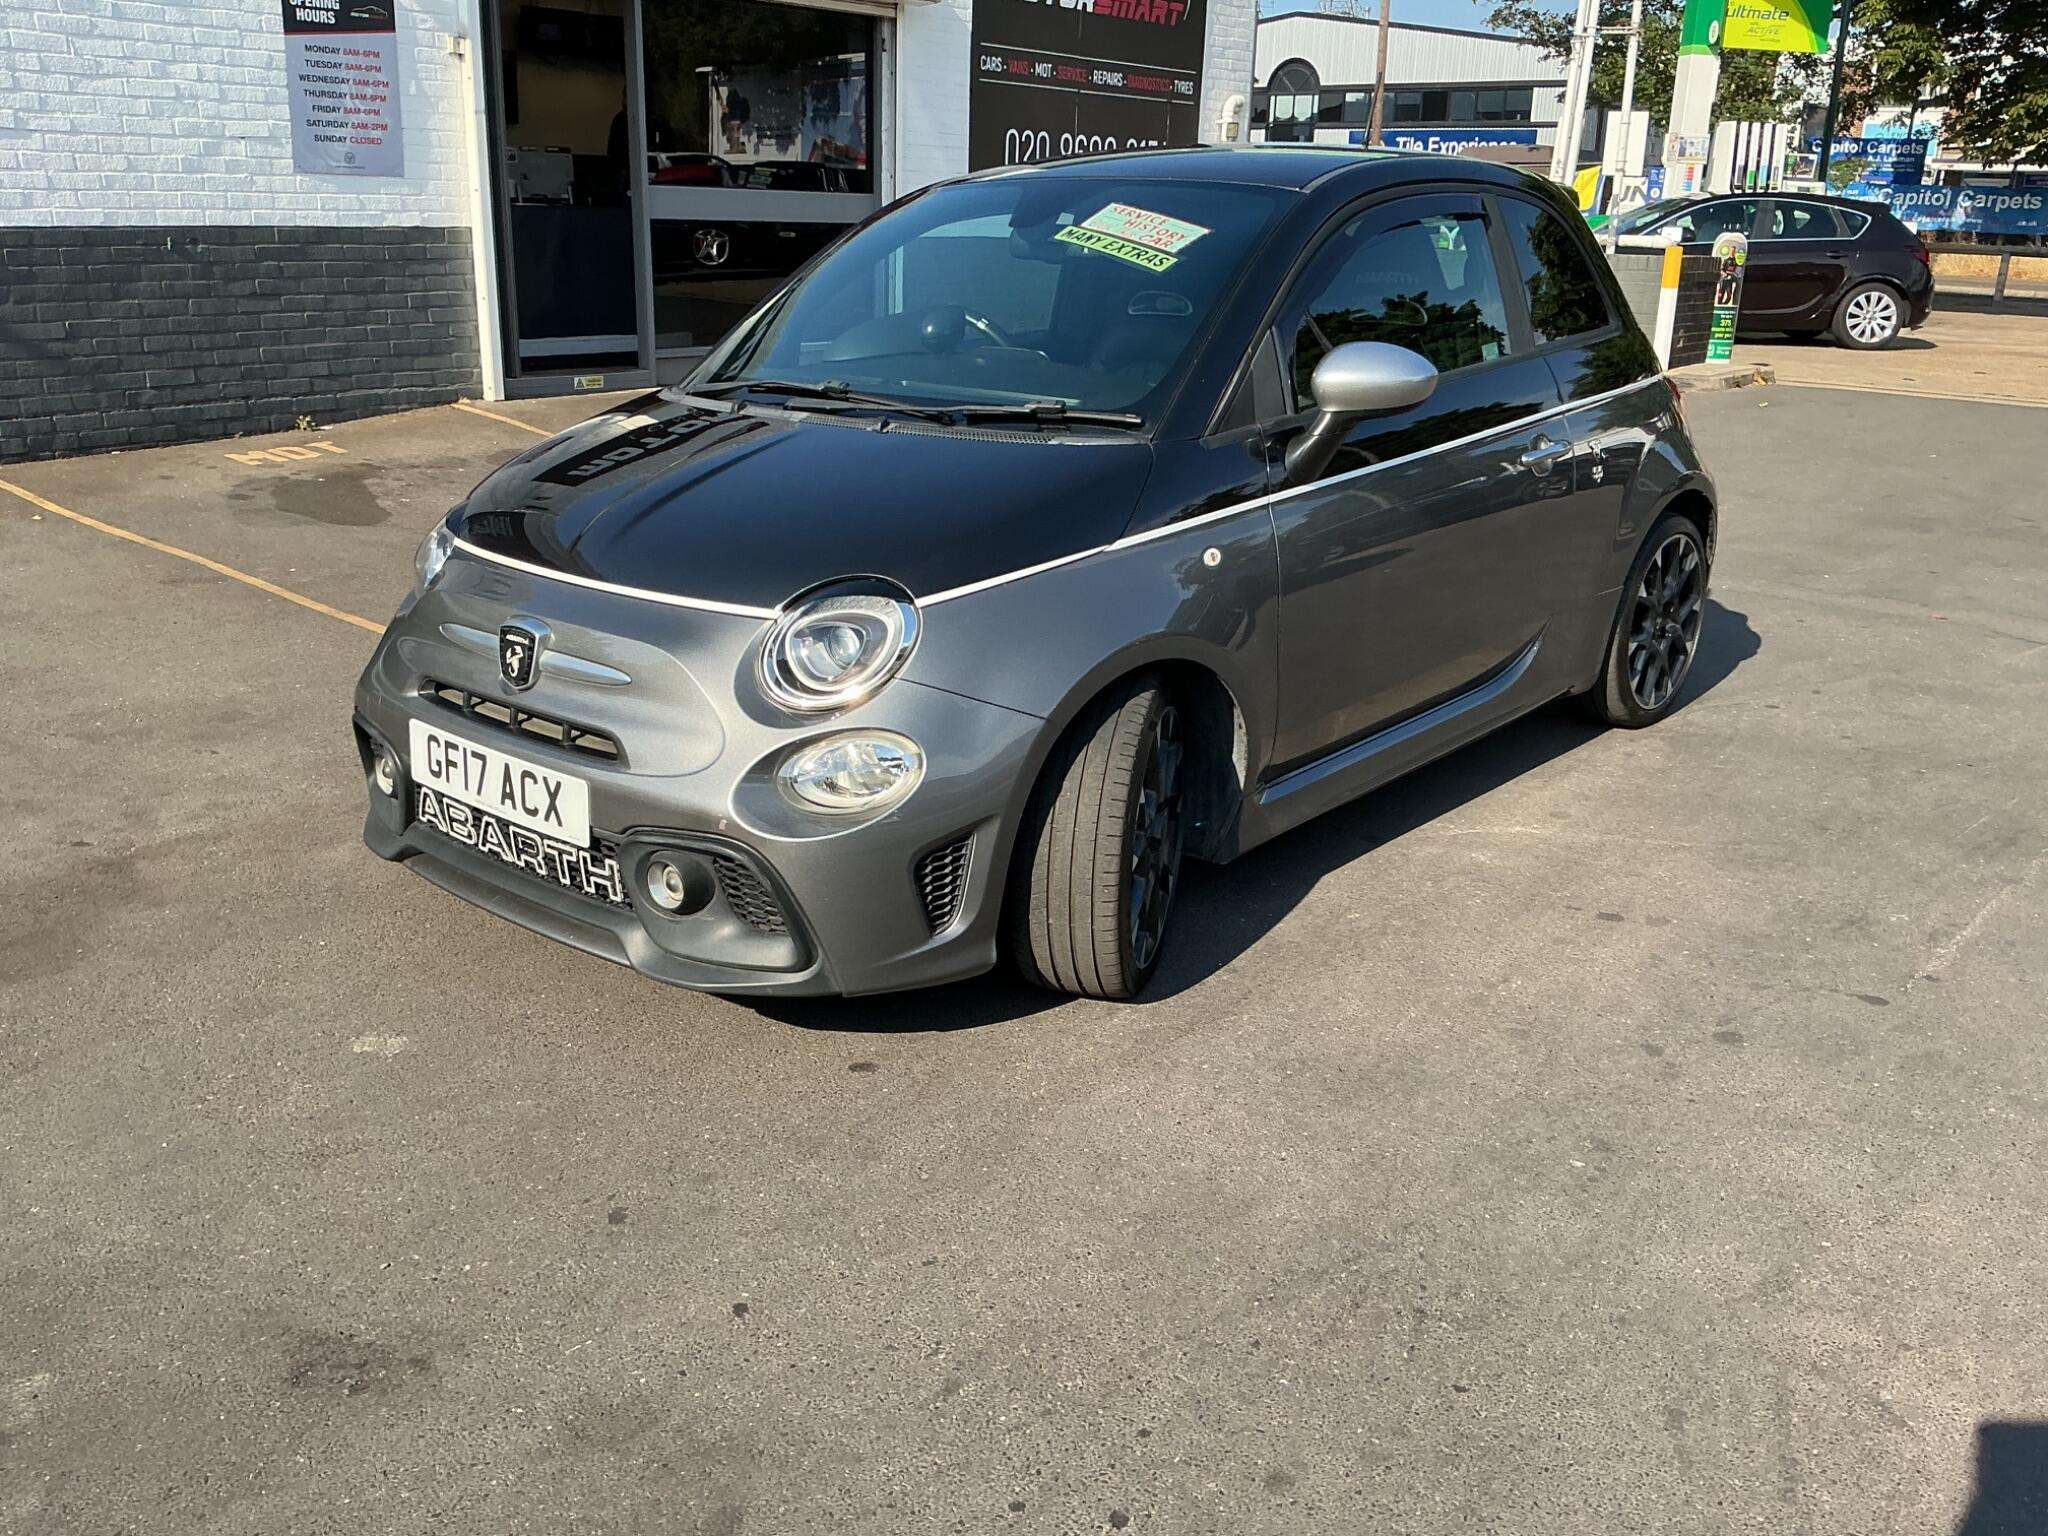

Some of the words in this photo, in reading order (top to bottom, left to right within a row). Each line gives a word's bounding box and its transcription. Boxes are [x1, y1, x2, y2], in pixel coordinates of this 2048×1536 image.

[296, 8, 336, 24] HOURS
[305, 45, 341, 55] MONDAY
[305, 59, 342, 70] TUESDAY
[298, 74, 351, 85] WEDNESDAY
[980, 55, 1002, 72] CARS
[1035, 62, 1053, 79] MOT
[1092, 71, 1123, 87] REPAIRS
[1174, 79, 1194, 95] TYRES
[304, 89, 348, 100] THURSDAY
[312, 104, 341, 115] FRIDAY
[306, 119, 349, 129] SATURDAY
[314, 134, 347, 144] SUNDAY
[350, 136, 382, 146] CLOSED
[1812, 140, 1863, 157] Cpitol
[1867, 141, 1924, 157] Carpets
[1879, 187, 1952, 211] Capitol
[1957, 189, 2043, 212] Carpets
[1113, 205, 1169, 225] SERVICE
[1123, 219, 1187, 242] HISTORY
[1062, 229, 1105, 246] MANY
[1103, 241, 1170, 268] EXTRAS
[224, 440, 348, 466] MOT
[427, 733, 487, 798] GF17
[501, 762, 563, 828] ACX
[418, 786, 625, 903] ABARTH
